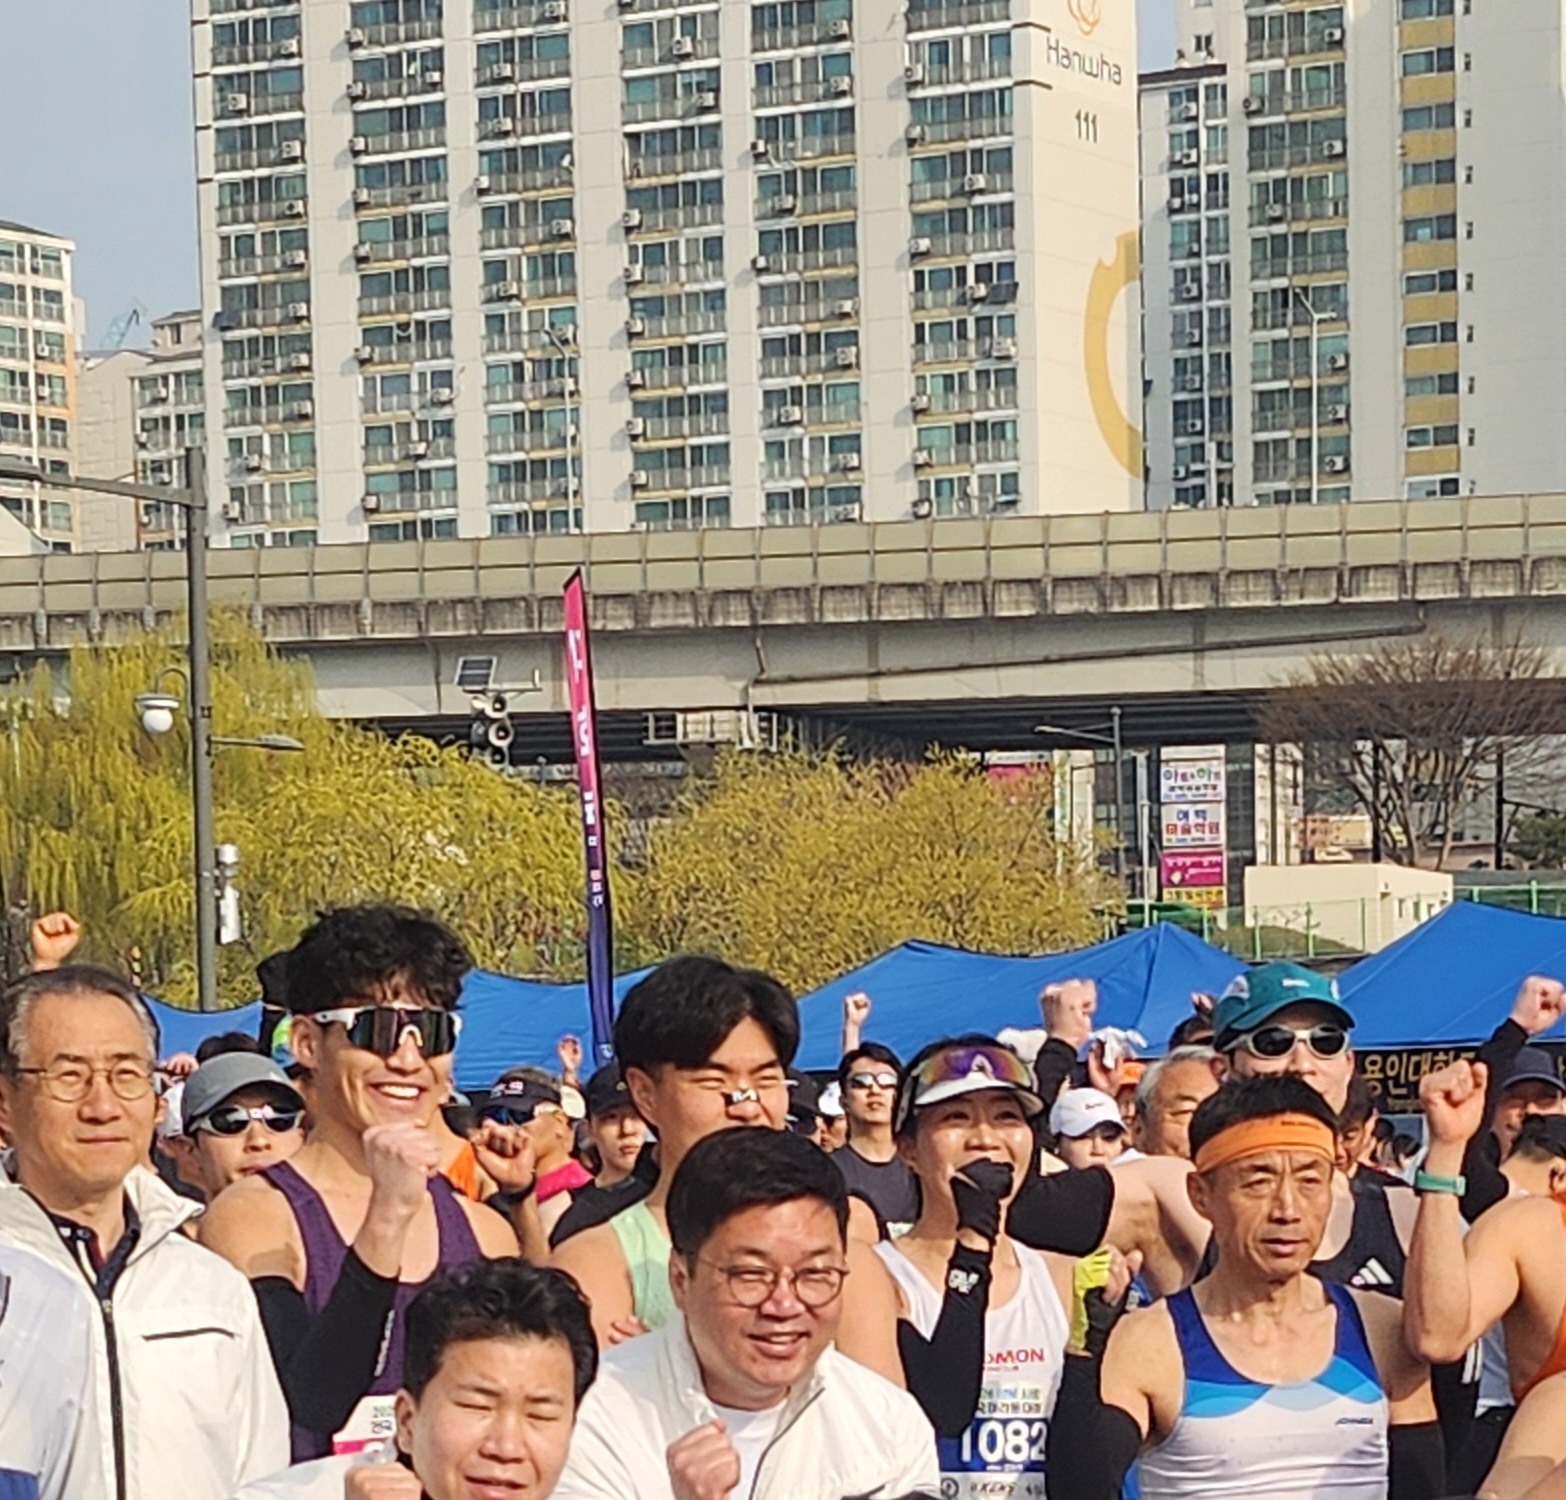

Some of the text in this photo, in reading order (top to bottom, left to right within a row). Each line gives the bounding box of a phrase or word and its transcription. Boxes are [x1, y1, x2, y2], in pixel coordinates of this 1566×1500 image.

[1046, 36, 1122, 86] Hanwha
[1074, 109, 1098, 143] 111
[961, 1420, 1048, 1463] 1082
